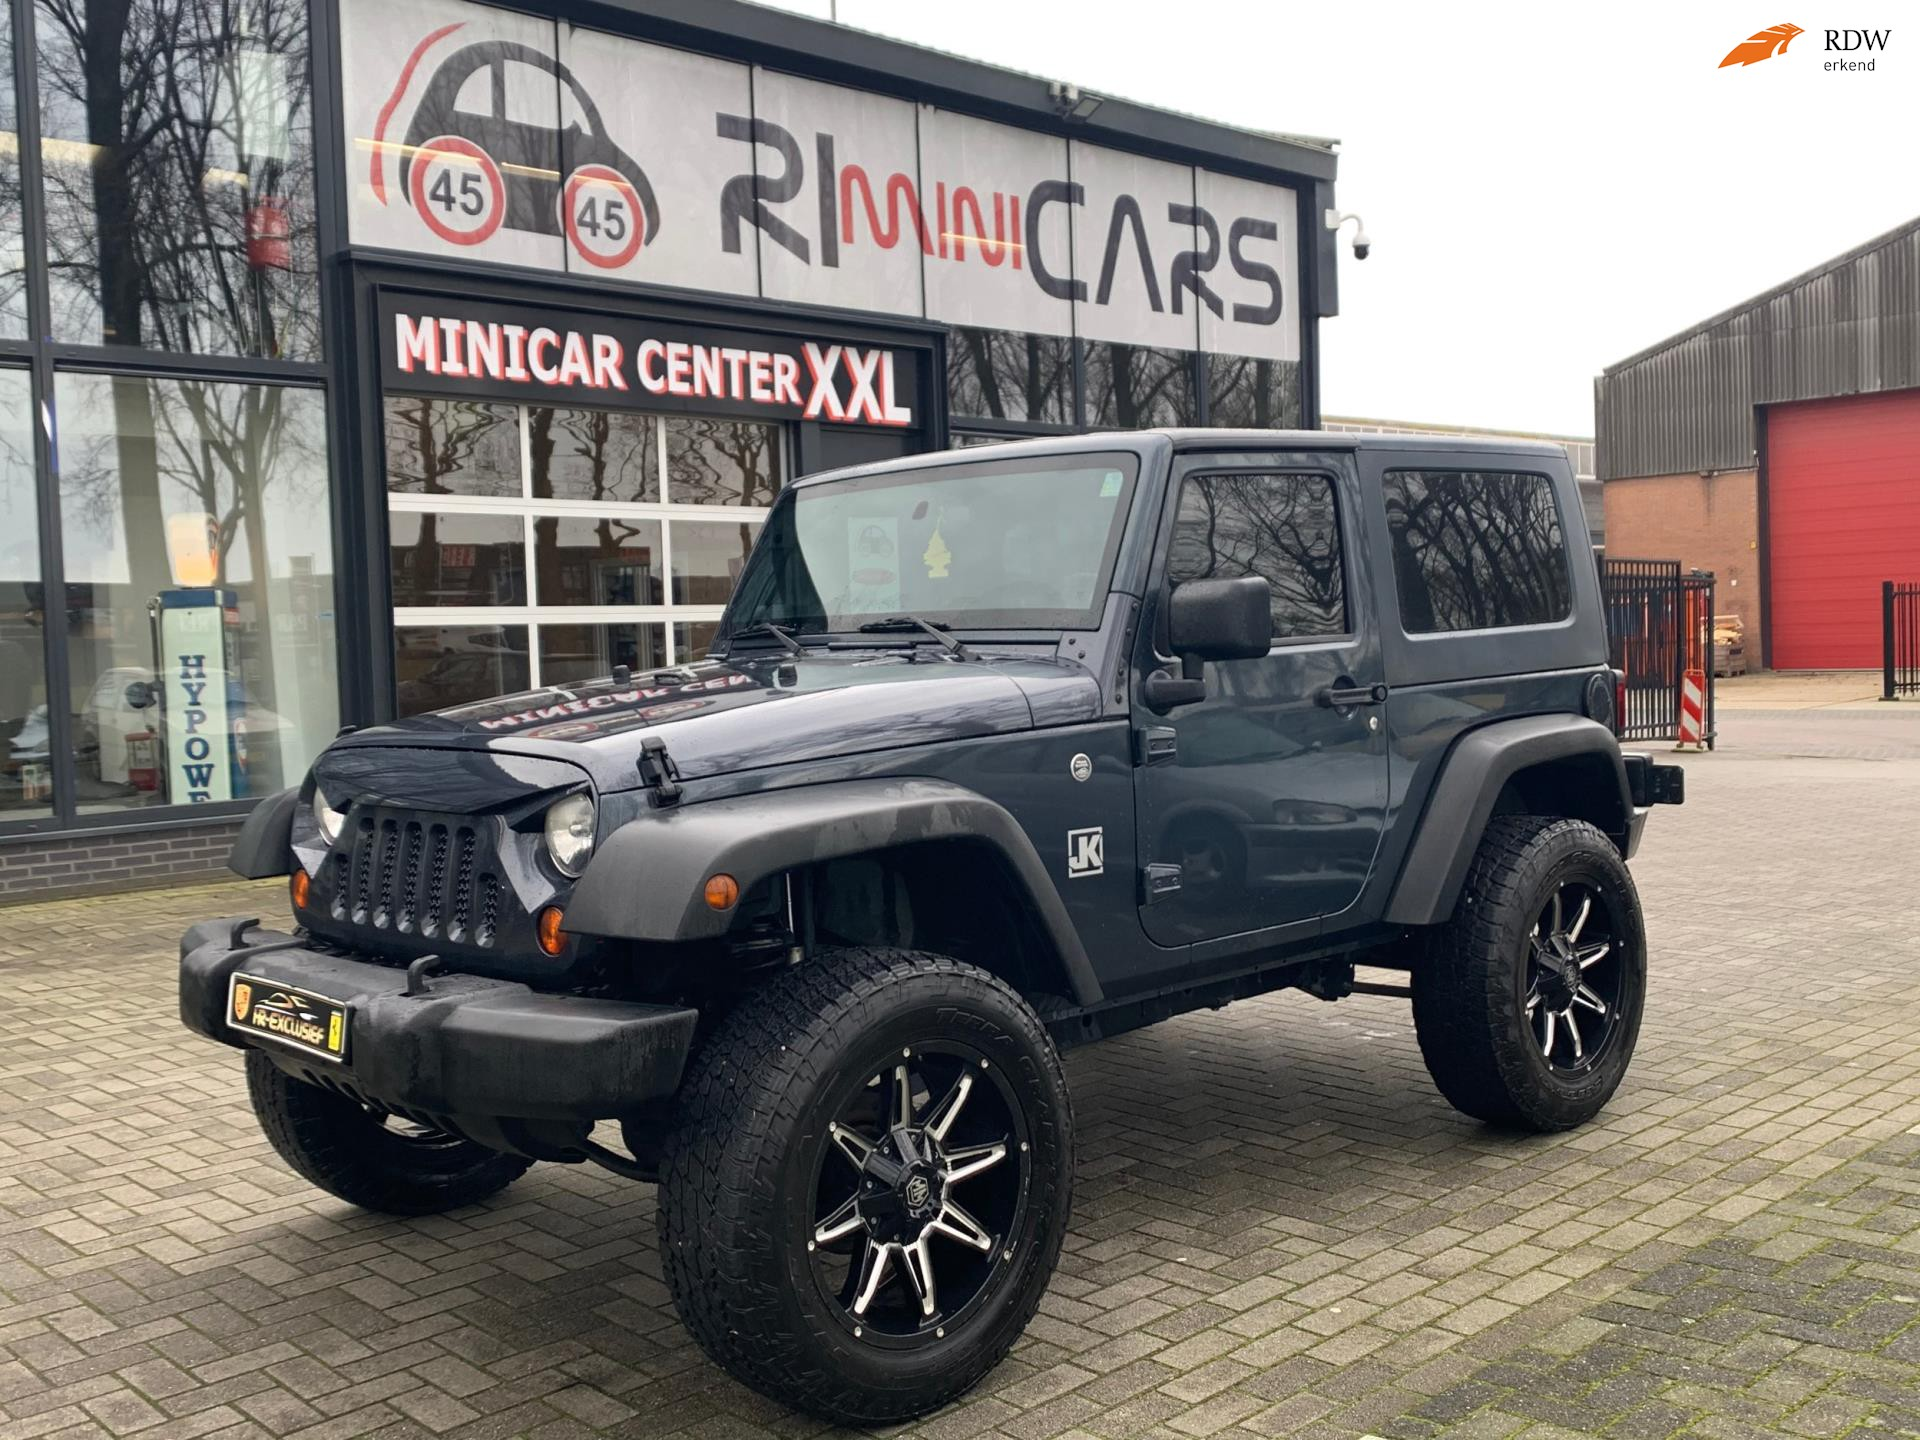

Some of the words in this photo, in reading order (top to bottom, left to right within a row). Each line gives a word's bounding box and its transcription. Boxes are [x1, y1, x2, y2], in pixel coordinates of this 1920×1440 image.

[429, 168, 484, 216] 45
[576, 196, 626, 241] 45
[715, 111, 1284, 326] RIMINICARS
[395, 313, 629, 391] MINICAR
[636, 338, 803, 405] CENTER
[801, 341, 912, 426] XXL
[1068, 833, 1103, 870] JK
